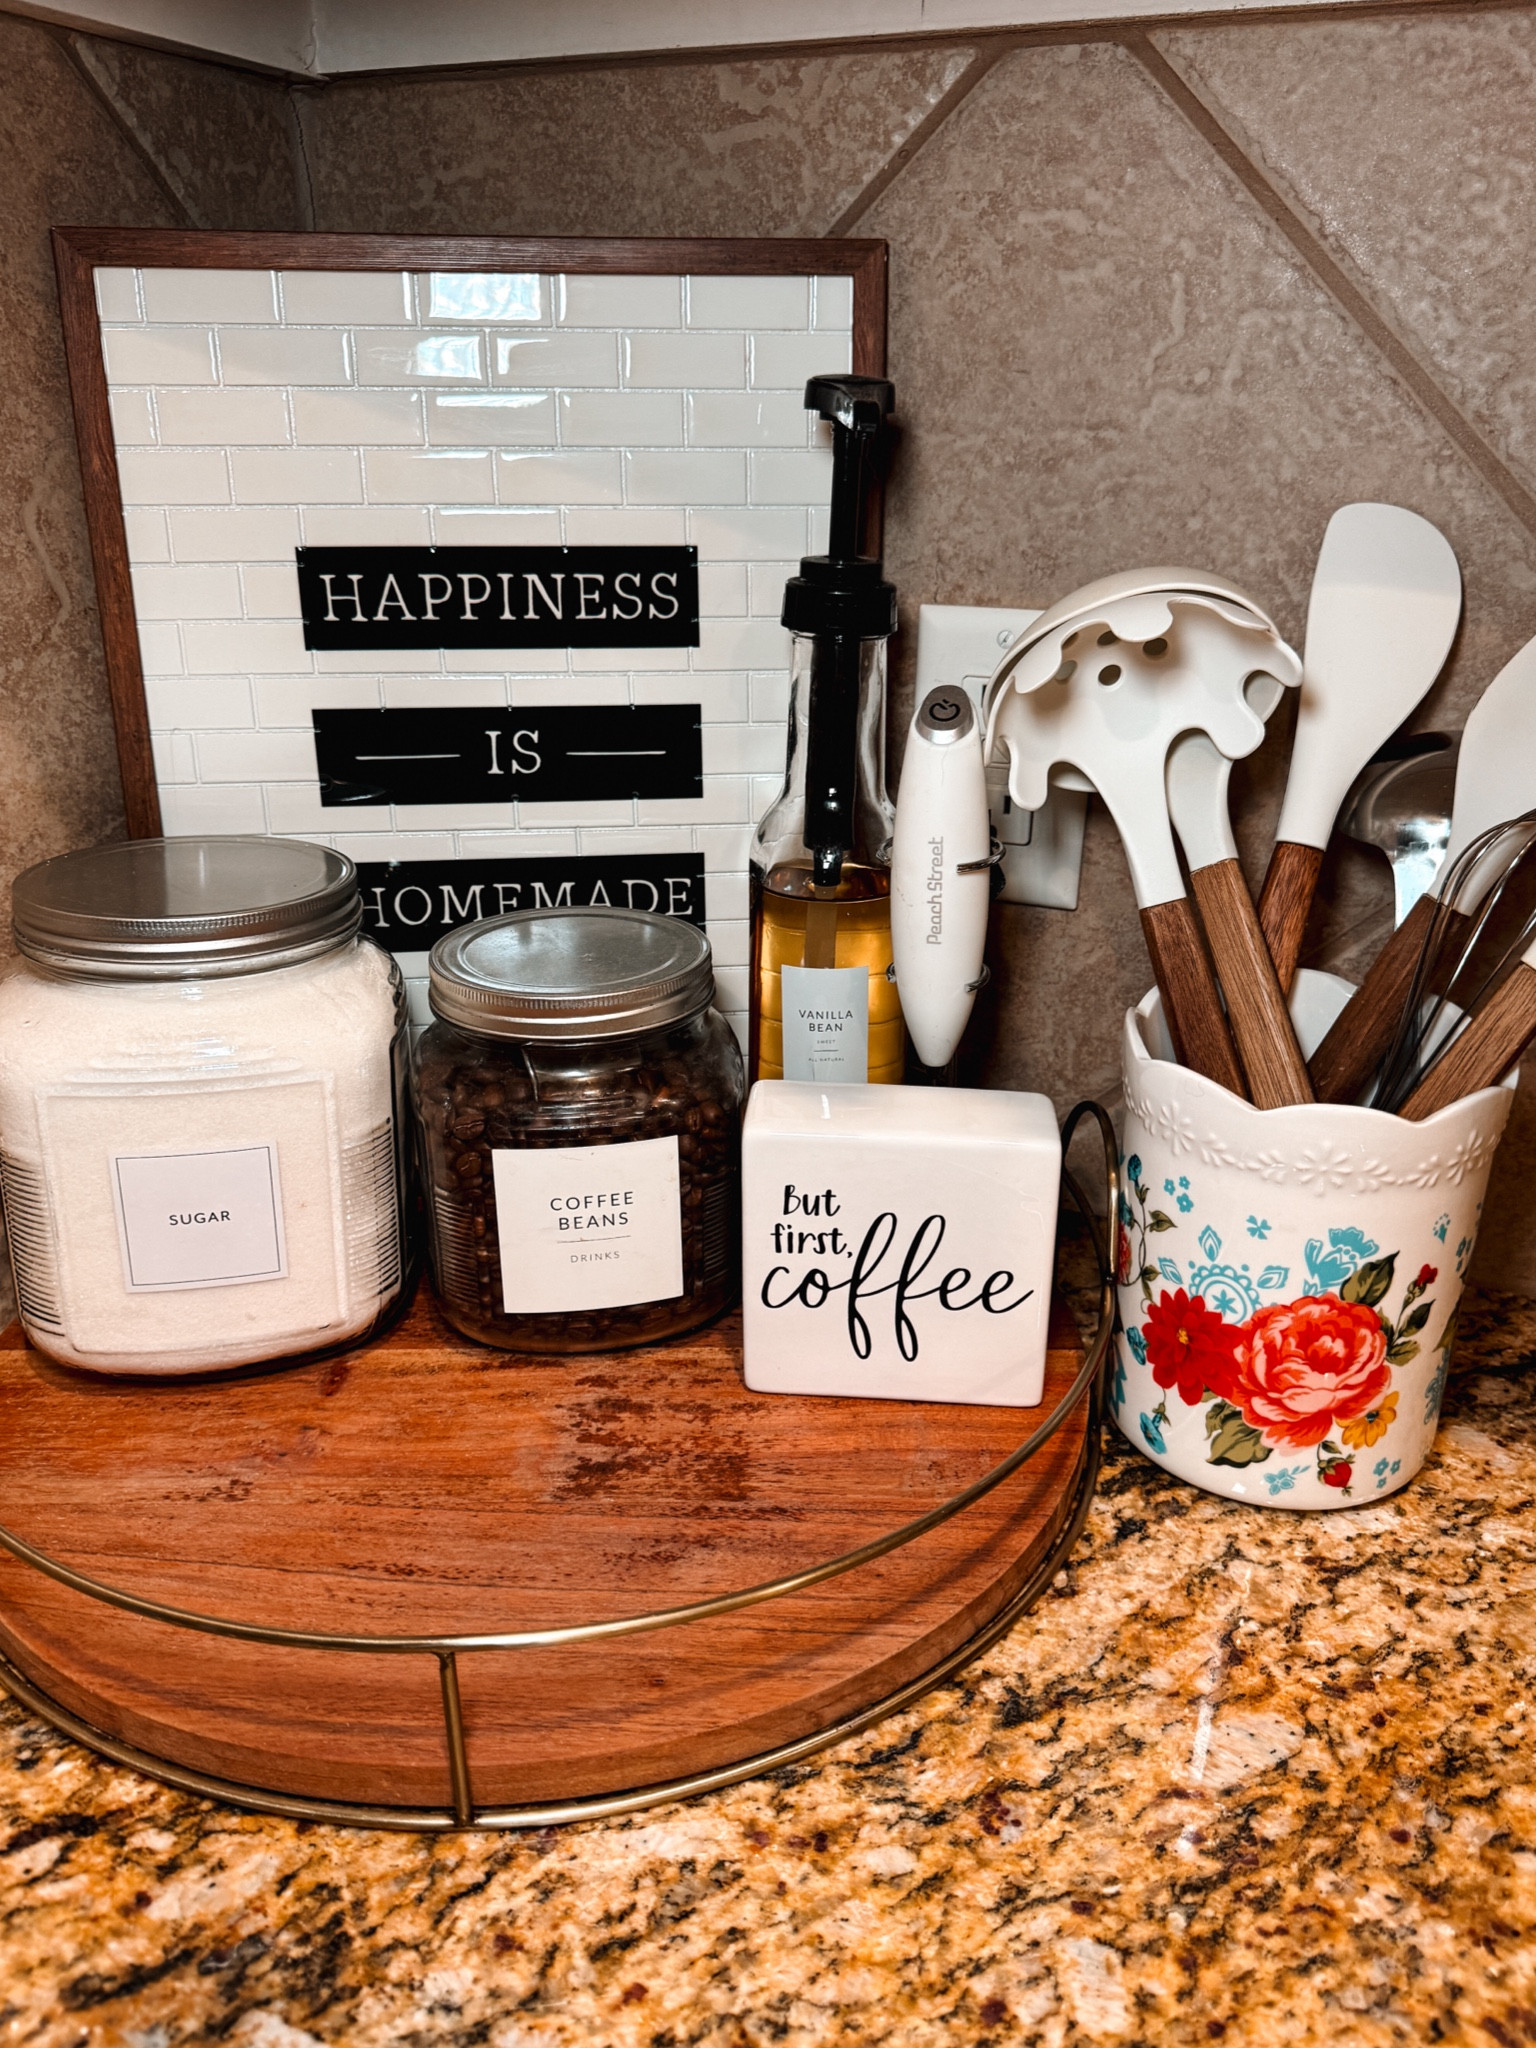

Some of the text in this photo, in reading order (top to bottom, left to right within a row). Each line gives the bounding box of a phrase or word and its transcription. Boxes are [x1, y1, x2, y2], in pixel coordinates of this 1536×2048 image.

[319, 571, 680, 621] HAPPINESS
[484, 729, 542, 775] IS
[926, 836, 944, 945] Peach Street
[798, 1009, 854, 1020] VANILLA
[808, 1022, 843, 1032] BEAN
[550, 1191, 634, 1211] COFFEE
[782, 1184, 841, 1217] But
[169, 1210, 231, 1226] SUGAR
[558, 1212, 629, 1231] BEANS
[770, 1222, 854, 1259] first,
[570, 1250, 621, 1264] DRINKS
[760, 1212, 1035, 1362] coffee
